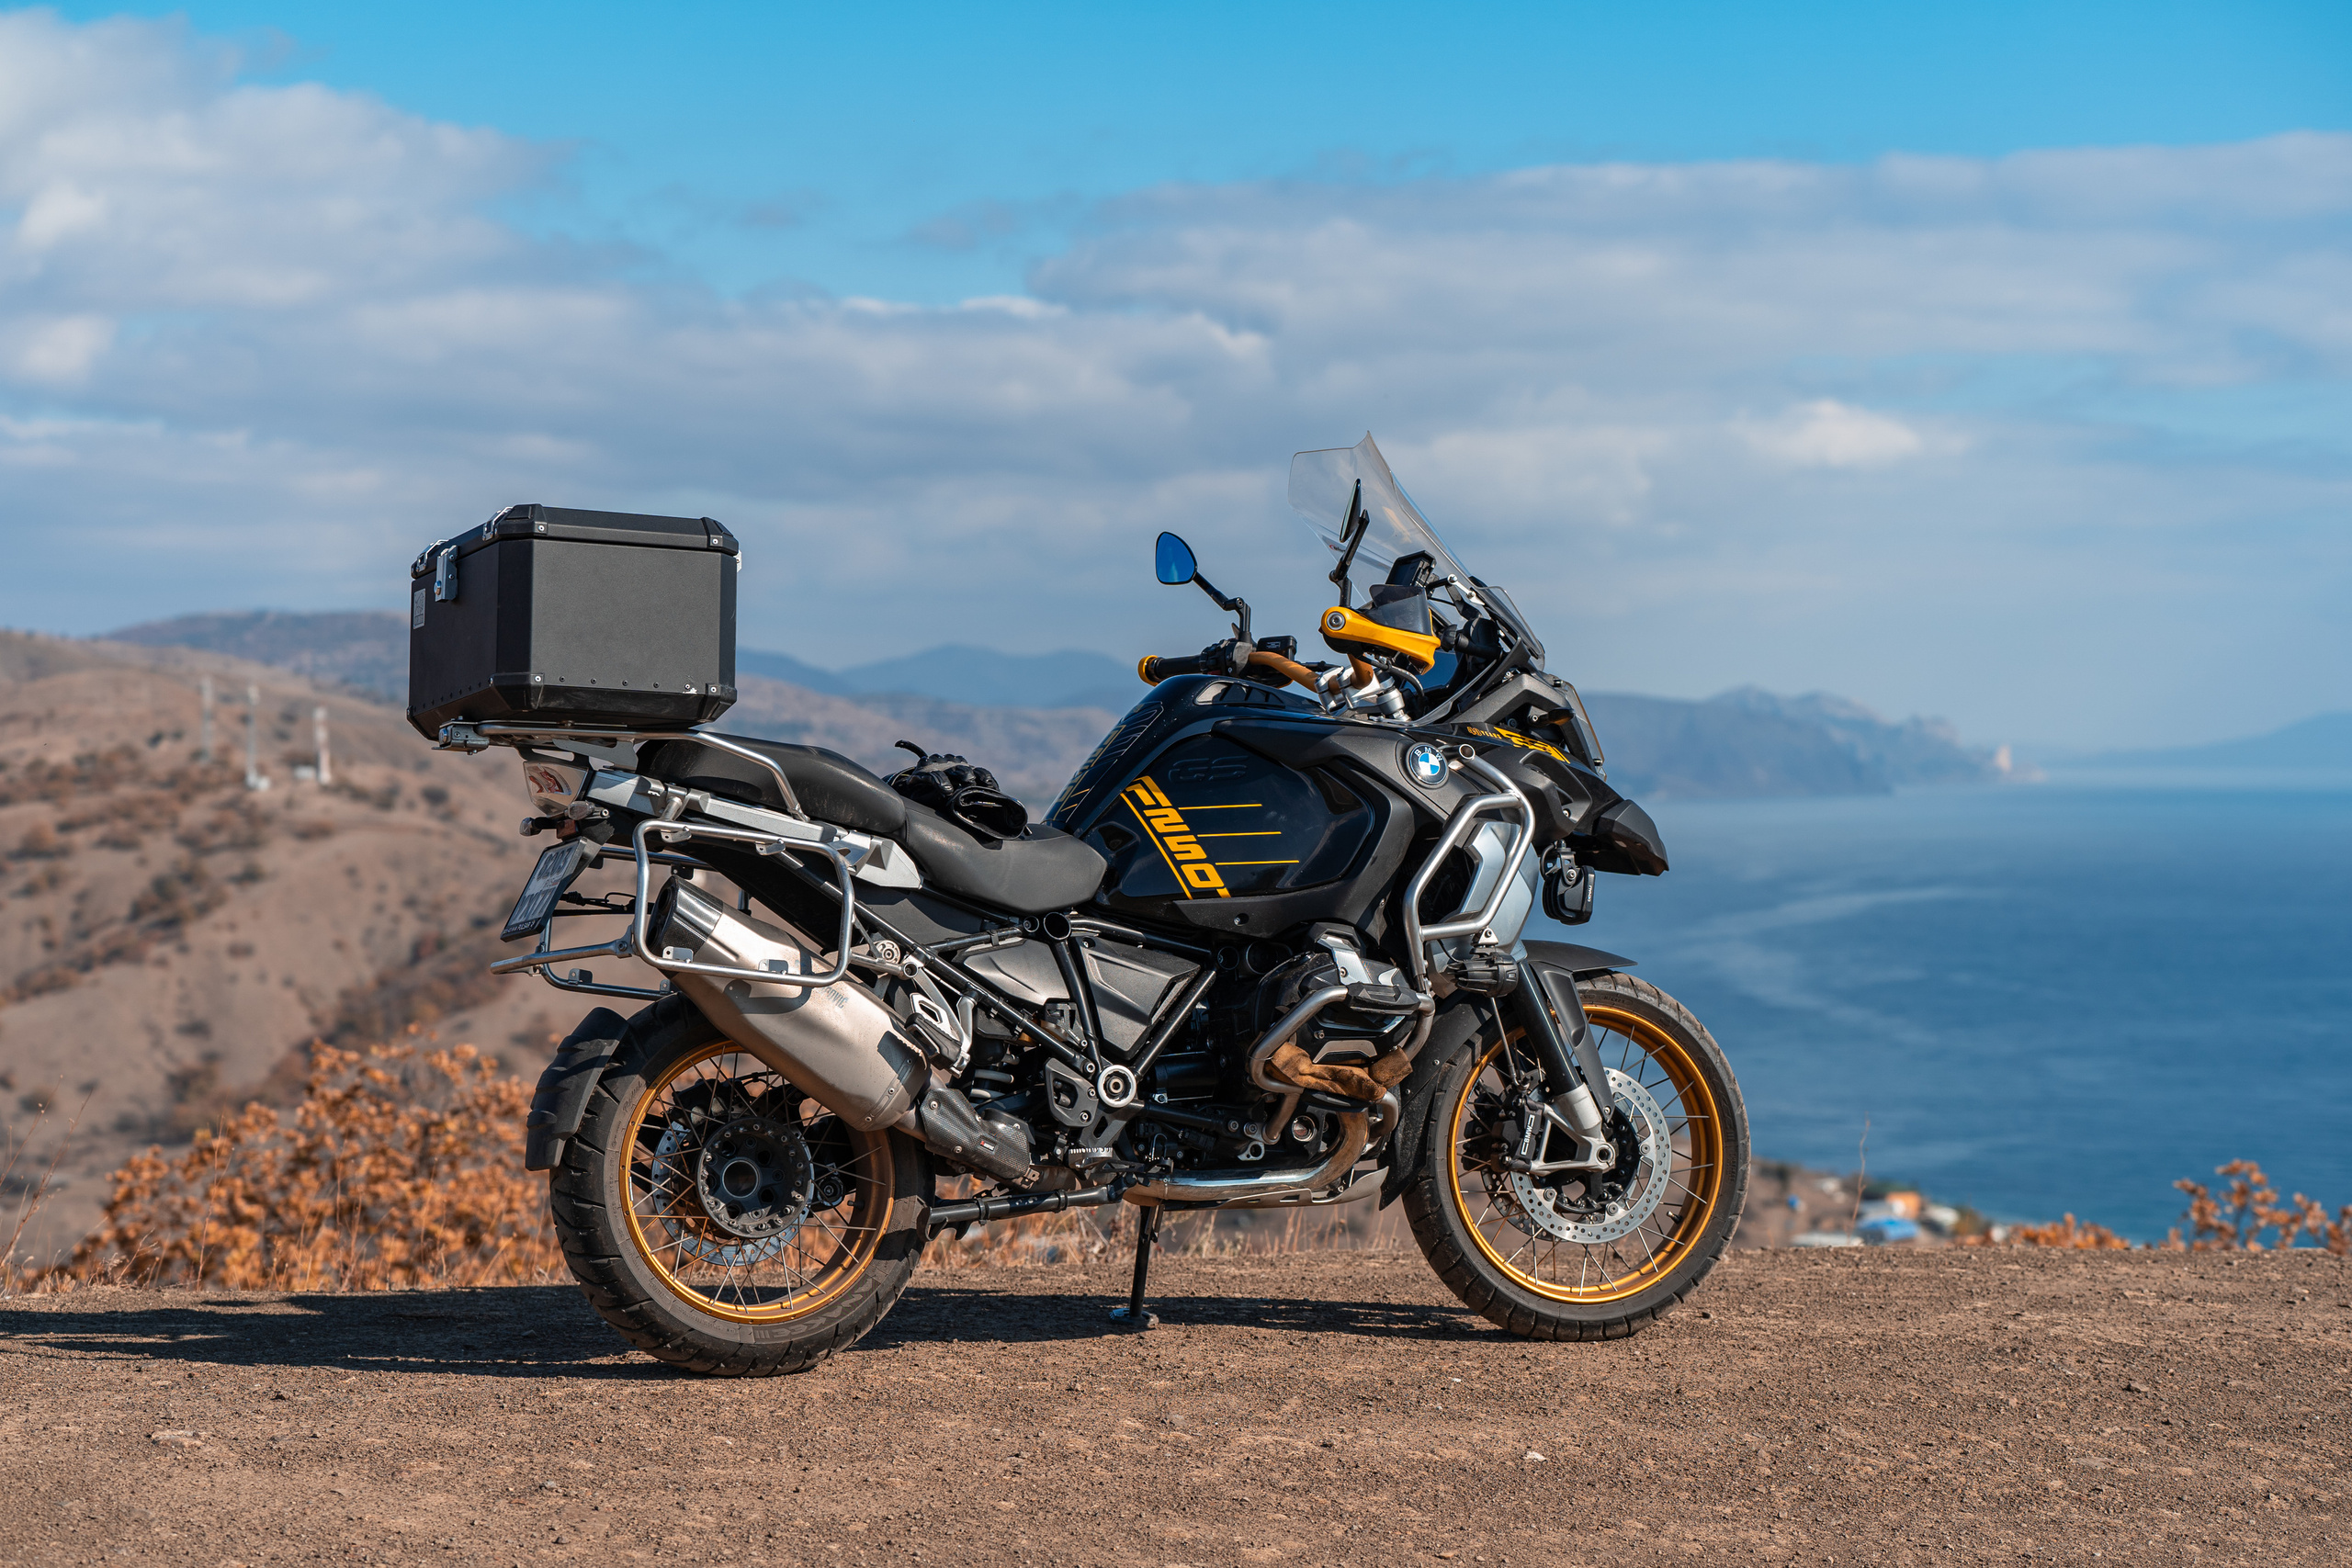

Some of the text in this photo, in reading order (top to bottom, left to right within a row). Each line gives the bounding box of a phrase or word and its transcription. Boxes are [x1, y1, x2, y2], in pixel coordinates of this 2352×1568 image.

[1414, 747, 1442, 761] BMW
[1168, 755, 1249, 783] GS
[1125, 777, 1224, 888] 1250
[1523, 1124, 1533, 1144] BMW
[773, 1278, 873, 1338] ANAKEE
